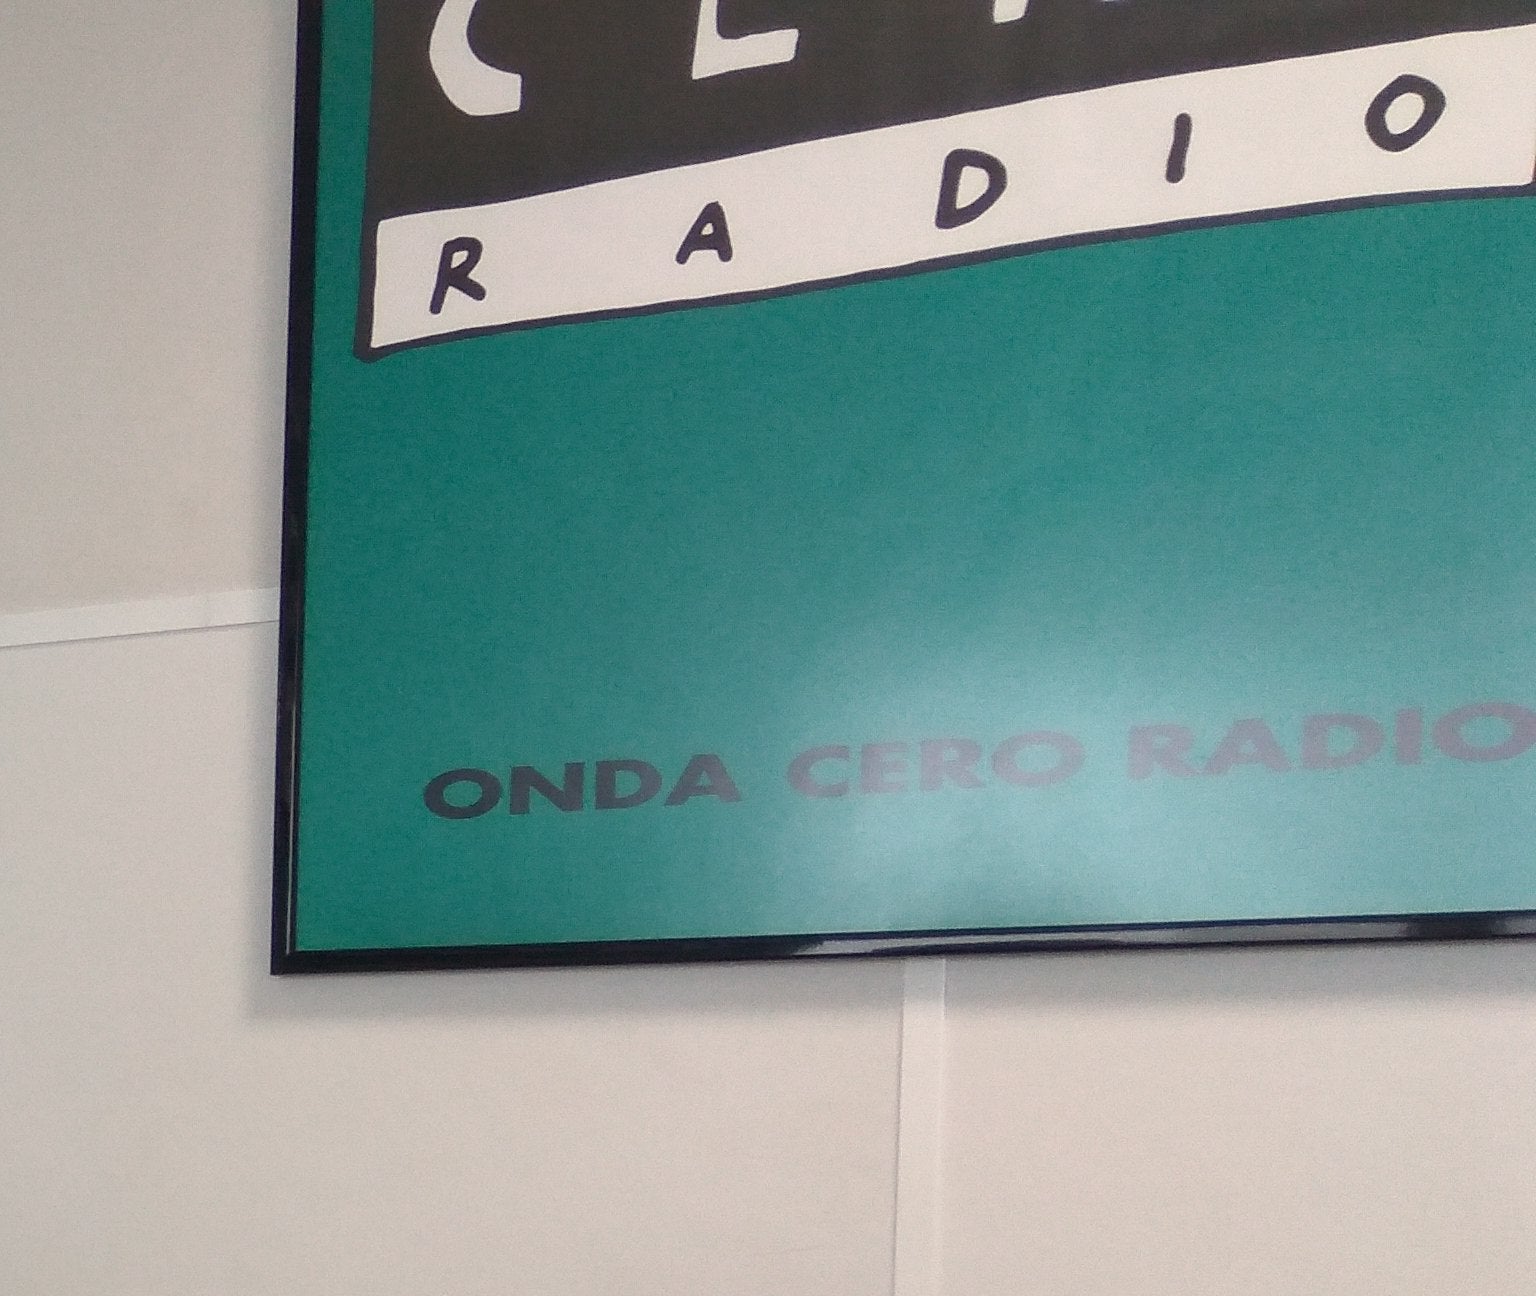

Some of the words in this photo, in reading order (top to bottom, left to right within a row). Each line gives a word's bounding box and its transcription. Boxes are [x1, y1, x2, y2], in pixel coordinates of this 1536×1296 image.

[429, 74, 1446, 315] RADIO
[423, 753, 743, 820] ONDA
[786, 730, 1088, 798] CERO
[1127, 702, 1536, 780] RADIO
